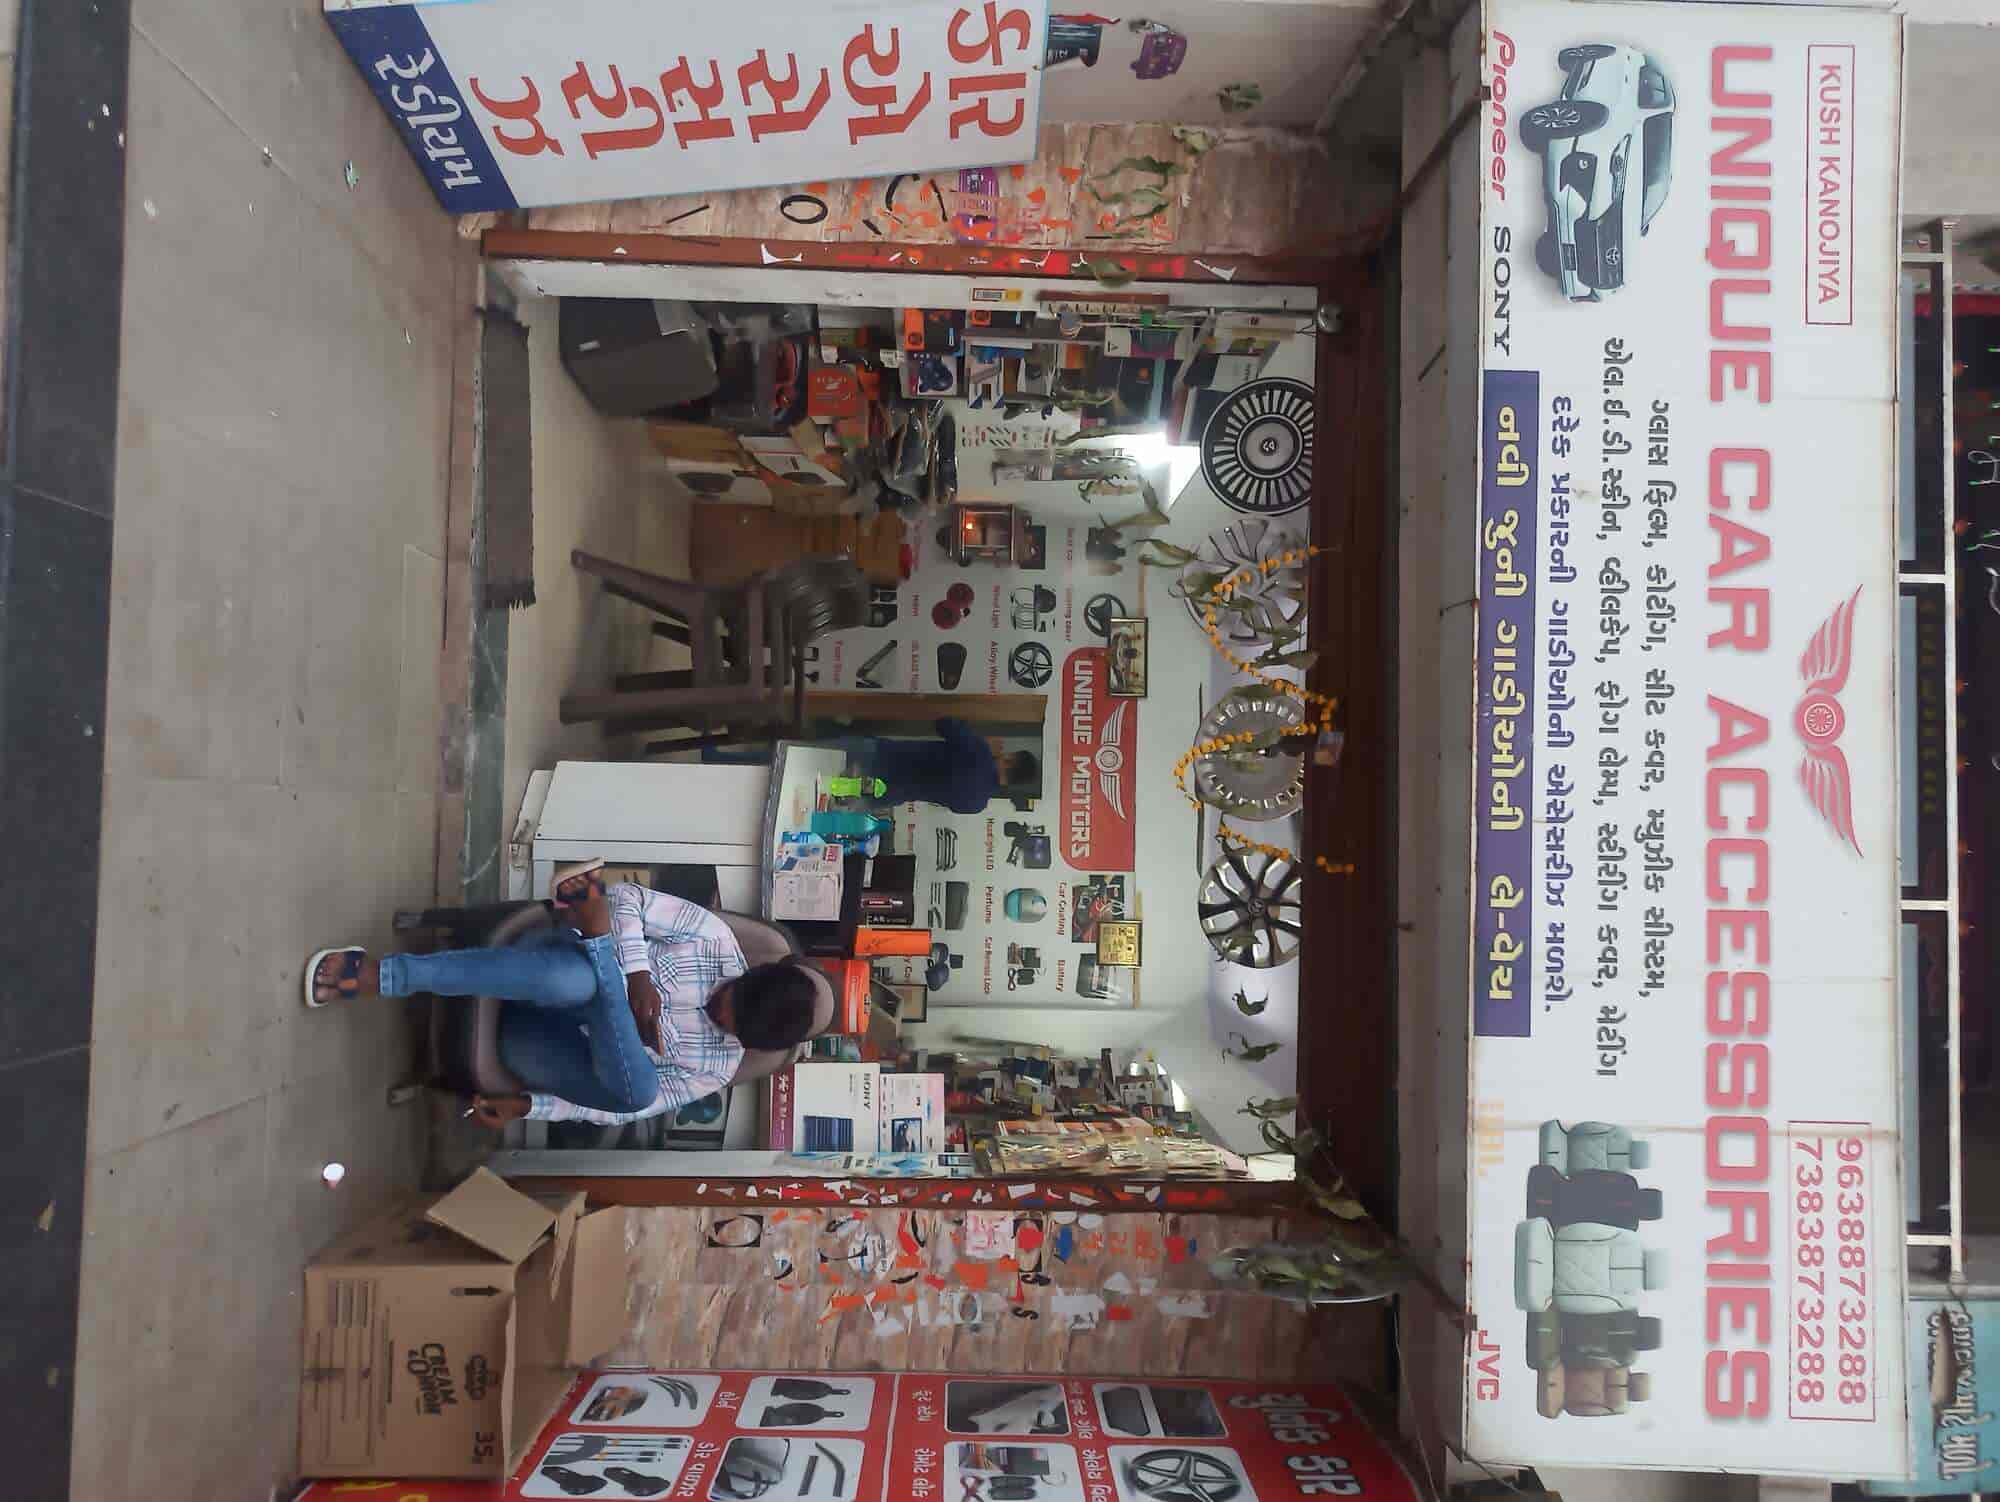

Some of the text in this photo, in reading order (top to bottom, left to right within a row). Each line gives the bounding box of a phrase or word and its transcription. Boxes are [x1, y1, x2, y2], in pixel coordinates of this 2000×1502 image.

[374, 47, 483, 190] રેડીયમ
[947, 1, 1032, 140] કાર
[1492, 30, 1516, 202] Pioneer
[1819, 65, 1840, 304] KUSH KANOJIYA
[1494, 227, 1510, 356] SONY
[1595, 557, 1630, 663] વ્હીલકેપ,
[1071, 659, 1092, 859] UNIQUE MOTORS
[1484, 407, 1529, 999] નવી જુની ગાડીઓની લે-વેચ
[1545, 396, 1579, 1011] દરેક પ્રકારની ગાડીઓની એસેસરીઝ મળશે.
[1595, 681, 1628, 733] ફોગ
[1634, 400, 1676, 997] ગ્લાસ ફિલ્મ, કોટીંગ, સીટ કવર, મ્યુઝીક સીસ્ટમ,
[1704, 45, 1773, 1421] UNIQUE CAR ACCESSORIES
[1593, 747, 1628, 805] લેમ્પ,
[1598, 823, 1627, 910] સ્ટીરીંગ
[1592, 924, 1617, 987] કવર,
[863, 1073, 871, 1110] SONY
[1597, 1006, 1627, 1075] મેટીંગ
[1796, 1136, 1824, 1402] 7383873288
[1837, 1137, 1866, 1404] 9638873288
[1477, 1329, 1500, 1401] JVC
[1287, 1455, 1361, 1495] કાર
